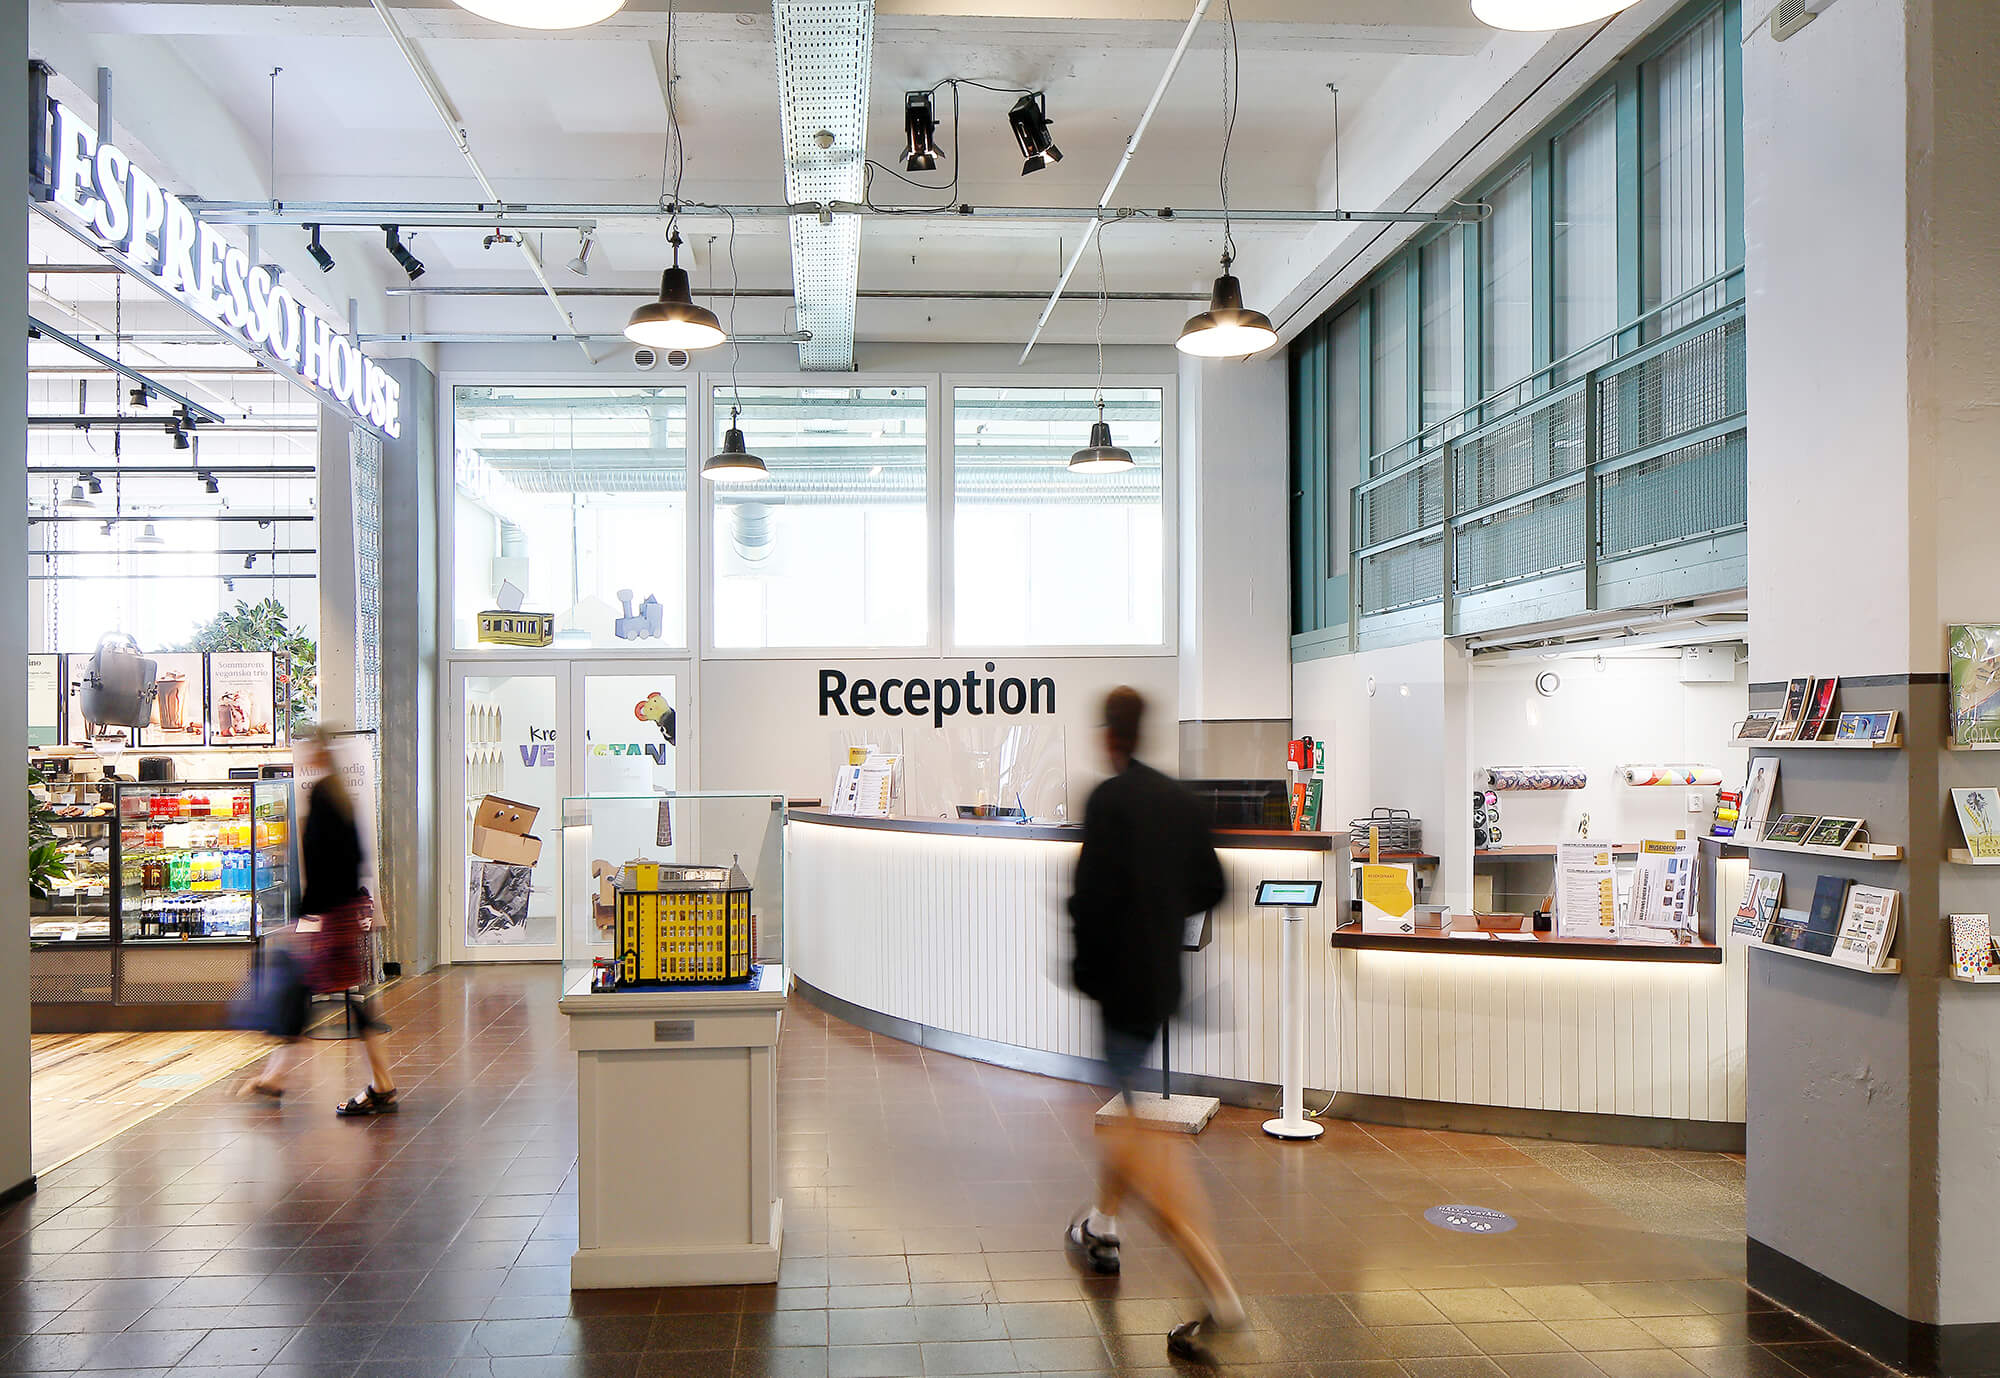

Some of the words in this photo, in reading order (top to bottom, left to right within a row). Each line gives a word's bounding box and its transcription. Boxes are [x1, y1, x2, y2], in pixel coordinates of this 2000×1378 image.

[53, 103, 300, 360] ESPRESSO
[303, 307, 401, 440] HOUSE
[253, 669, 269, 677] trio
[818, 661, 1056, 729] Reception
[529, 725, 557, 743] Kre
